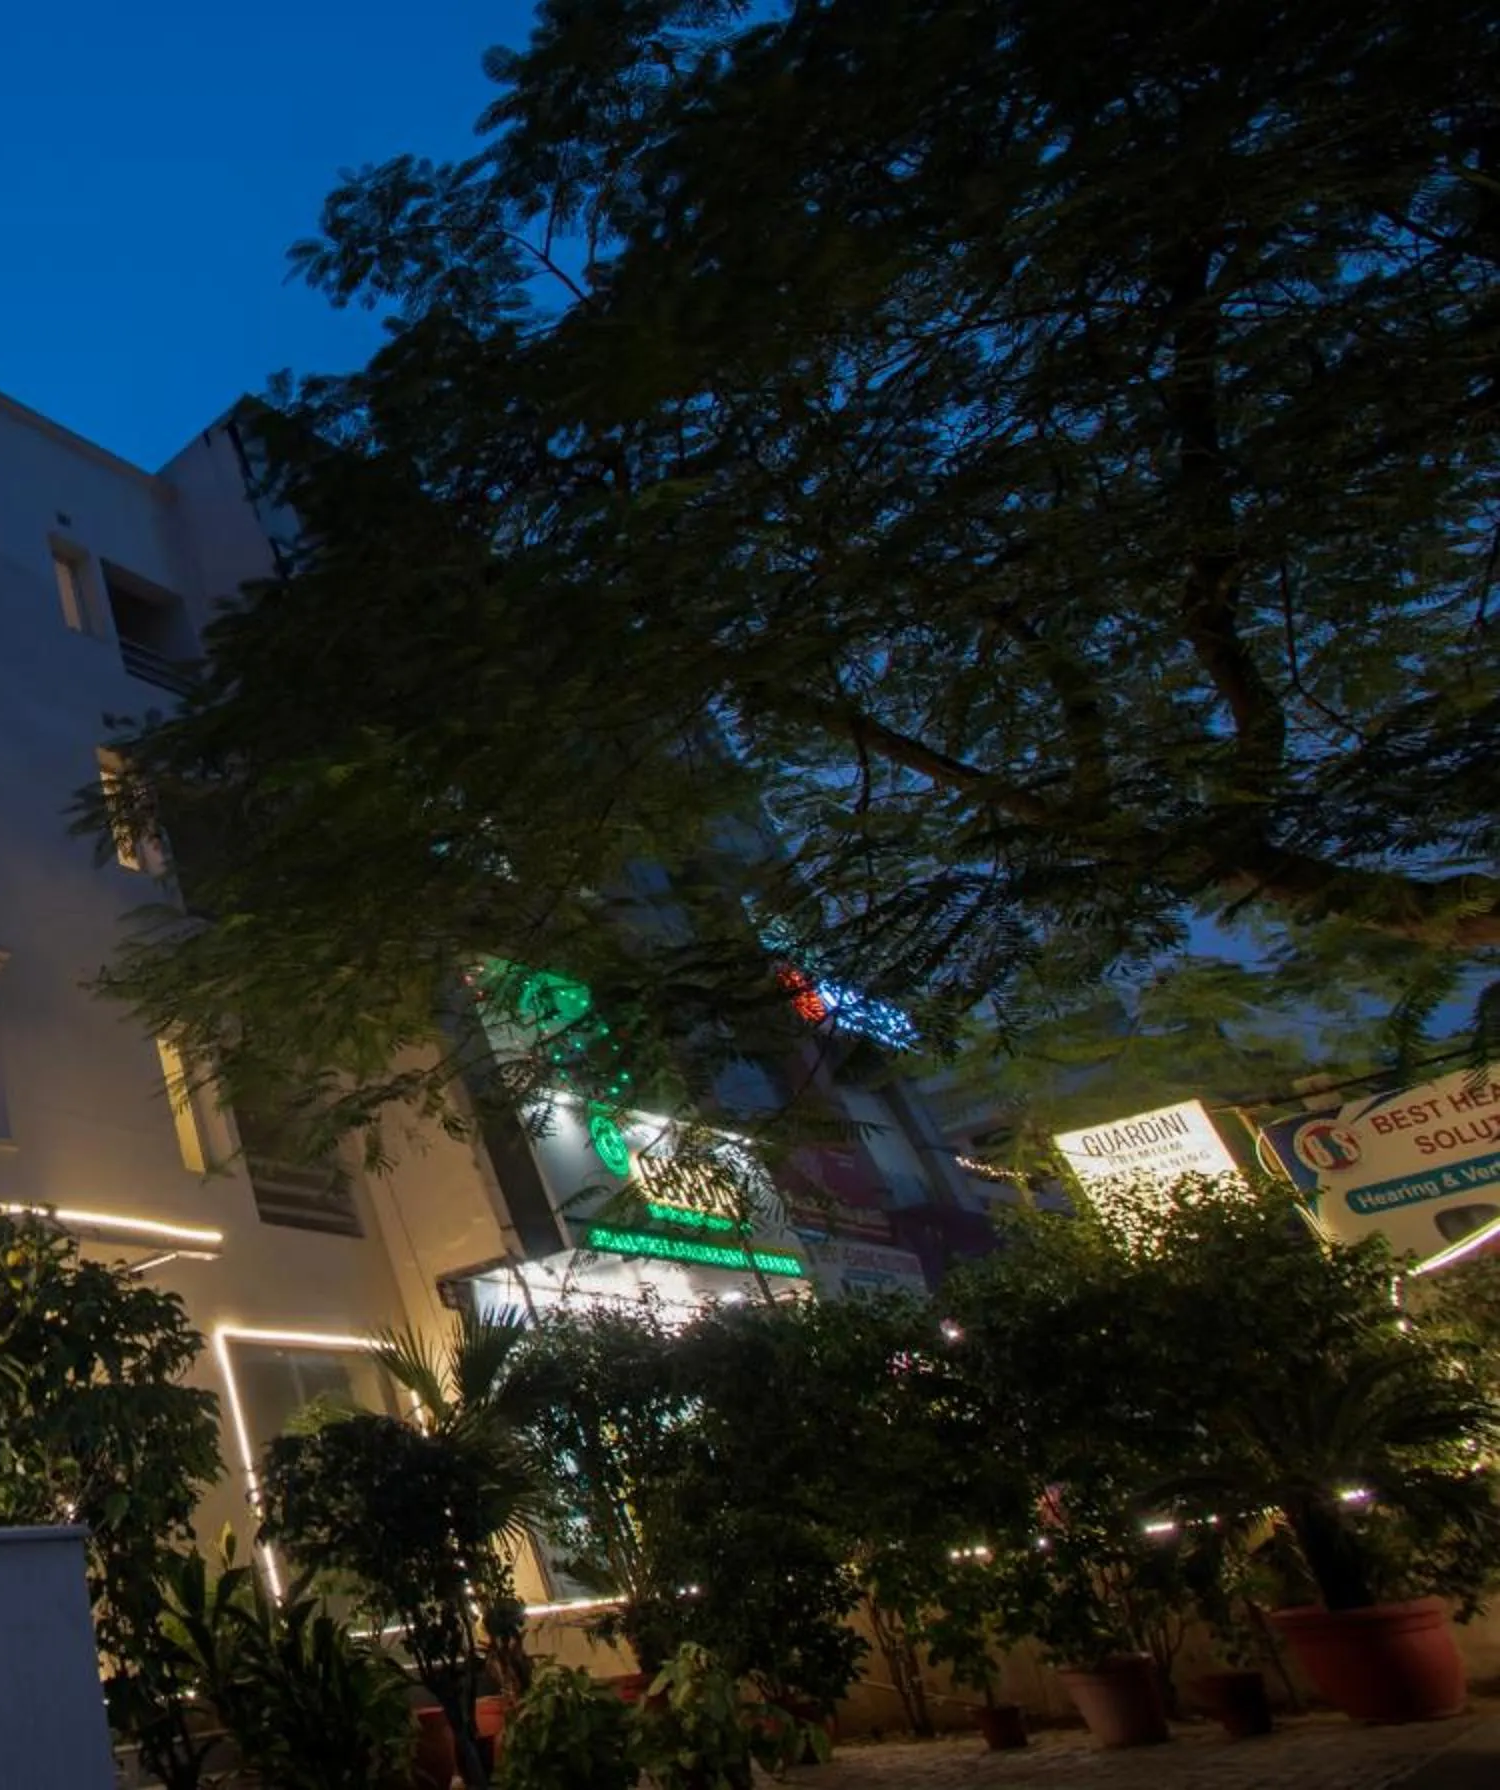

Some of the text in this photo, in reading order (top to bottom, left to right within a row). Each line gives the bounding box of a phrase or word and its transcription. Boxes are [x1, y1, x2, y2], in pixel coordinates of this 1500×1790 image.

[1370, 1099, 1442, 1135] BEST
[1356, 1180, 1440, 1208] Hearing
[1442, 1171, 1460, 1189] &
